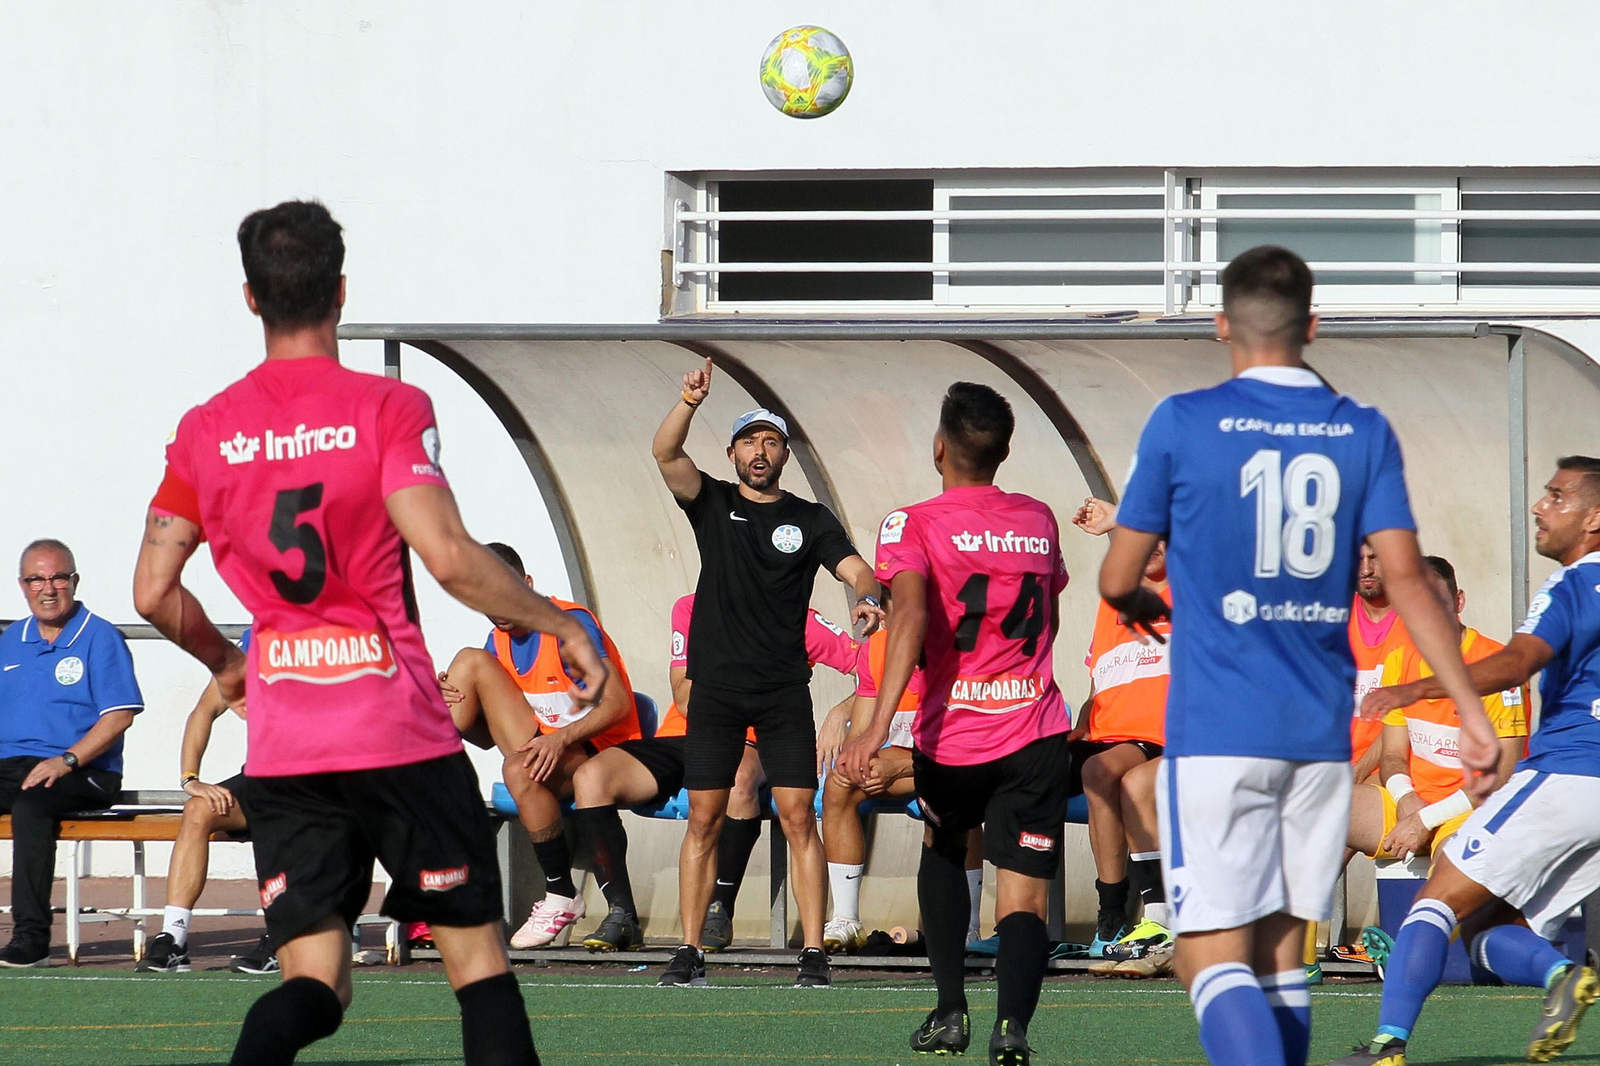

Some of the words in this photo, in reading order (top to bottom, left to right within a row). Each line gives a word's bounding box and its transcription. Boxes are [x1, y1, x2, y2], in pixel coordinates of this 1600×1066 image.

[265, 424, 356, 461] Infrico
[1240, 449, 1341, 579] 18
[268, 482, 327, 605] 5
[984, 529, 1050, 554] Infrico
[954, 573, 1044, 657] 14
[268, 633, 383, 668] CAMPOARAS
[951, 678, 1036, 702] CAMPOARAS
[423, 867, 466, 886] CAMPOARAS
